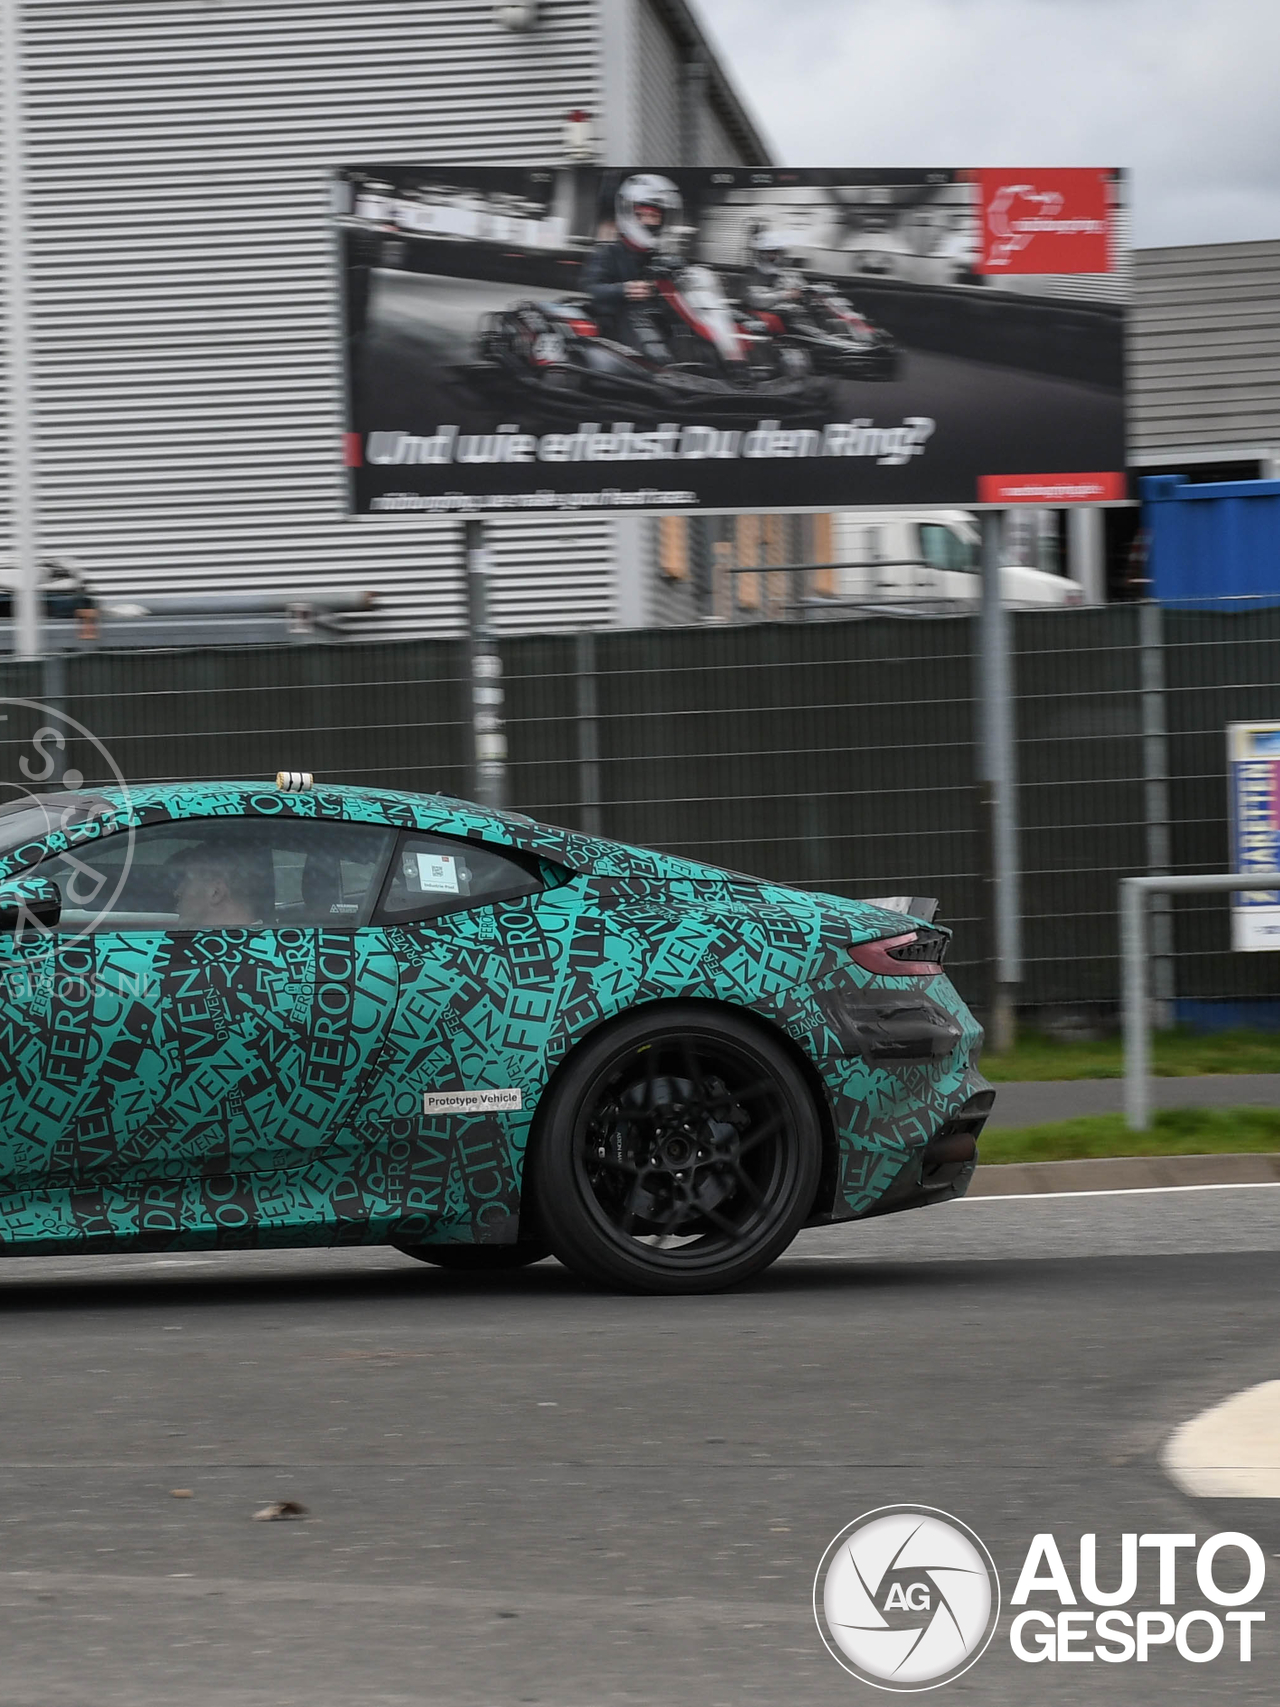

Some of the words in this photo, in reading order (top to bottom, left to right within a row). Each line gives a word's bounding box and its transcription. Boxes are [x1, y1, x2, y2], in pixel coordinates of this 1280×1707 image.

[367, 425, 458, 465] Und
[457, 424, 538, 463] wie
[538, 423, 679, 462] erlebst
[680, 424, 742, 459] Du
[743, 419, 819, 459] den
[821, 416, 936, 466] Ring?
[1237, 763, 1279, 904] ZGARETTEN
[428, 1096, 478, 1107] Prototype
[480, 1092, 518, 1104] Vehicle
